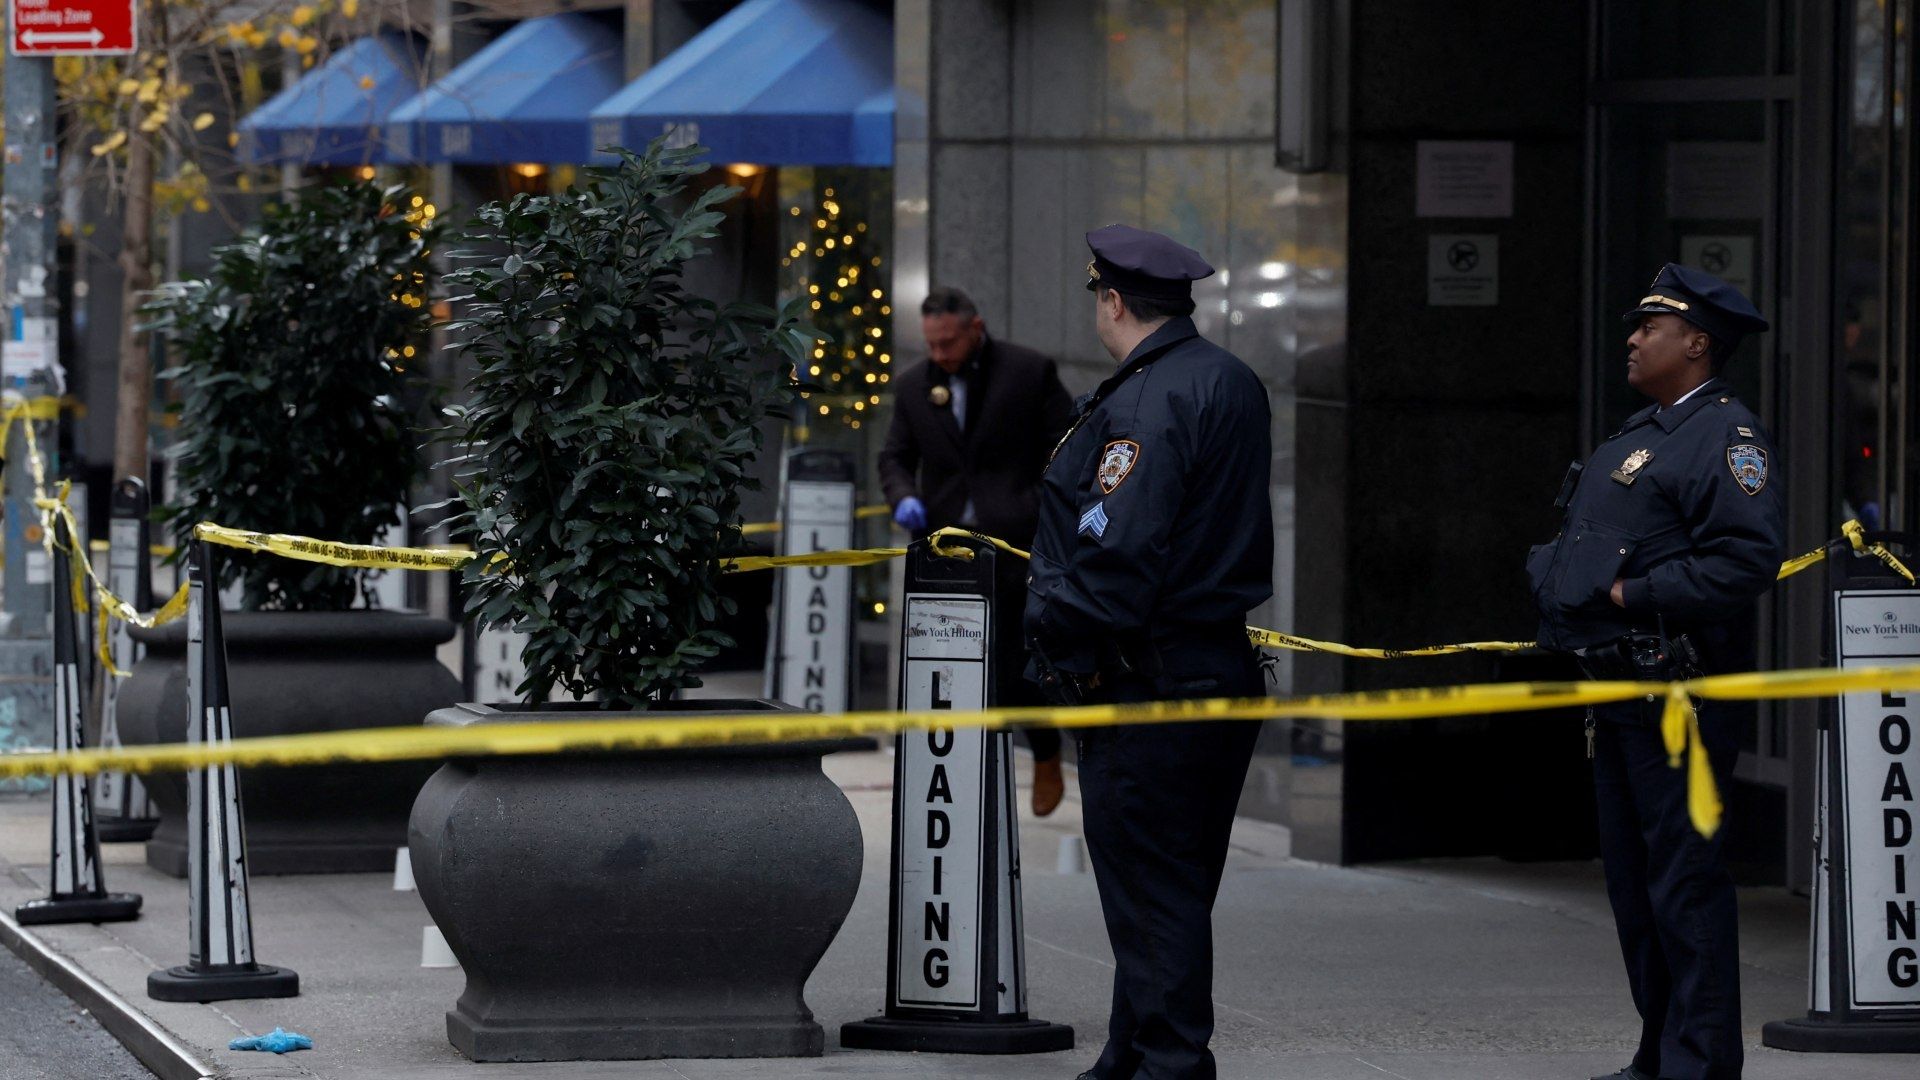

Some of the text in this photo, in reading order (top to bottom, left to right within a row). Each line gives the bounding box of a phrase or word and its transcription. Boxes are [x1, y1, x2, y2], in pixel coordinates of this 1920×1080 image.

[18, 8, 93, 26] Loading Zone
[930, 627, 950, 637] York
[951, 627, 981, 638] Hilton
[1846, 624, 1871, 635] New
[1873, 624, 1898, 635] York
[923, 671, 954, 988] LOADING
